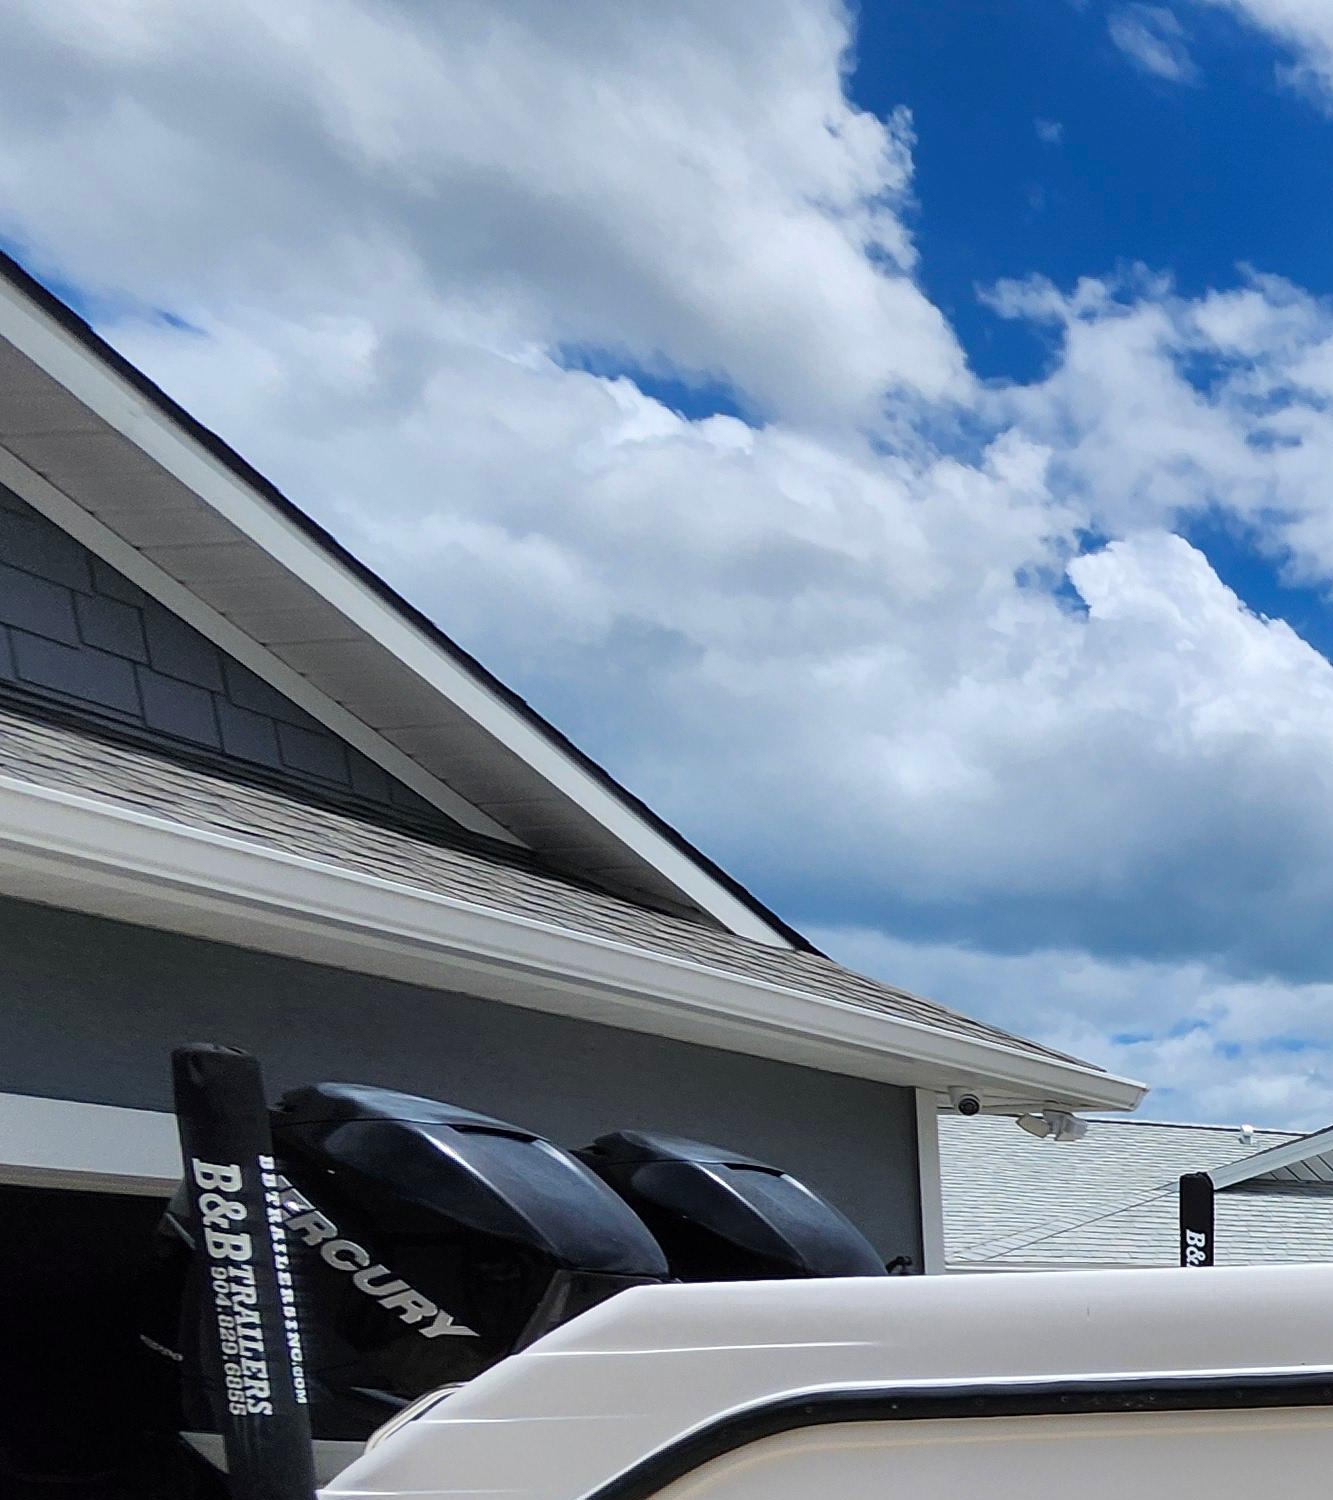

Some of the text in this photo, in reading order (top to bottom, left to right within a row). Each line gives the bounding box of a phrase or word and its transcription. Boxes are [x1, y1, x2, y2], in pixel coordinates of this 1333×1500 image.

[191, 1157, 273, 1416] B&B TRAILERS
[275, 1174, 481, 1338] ERCURY
[1185, 1229, 1206, 1267] B&
